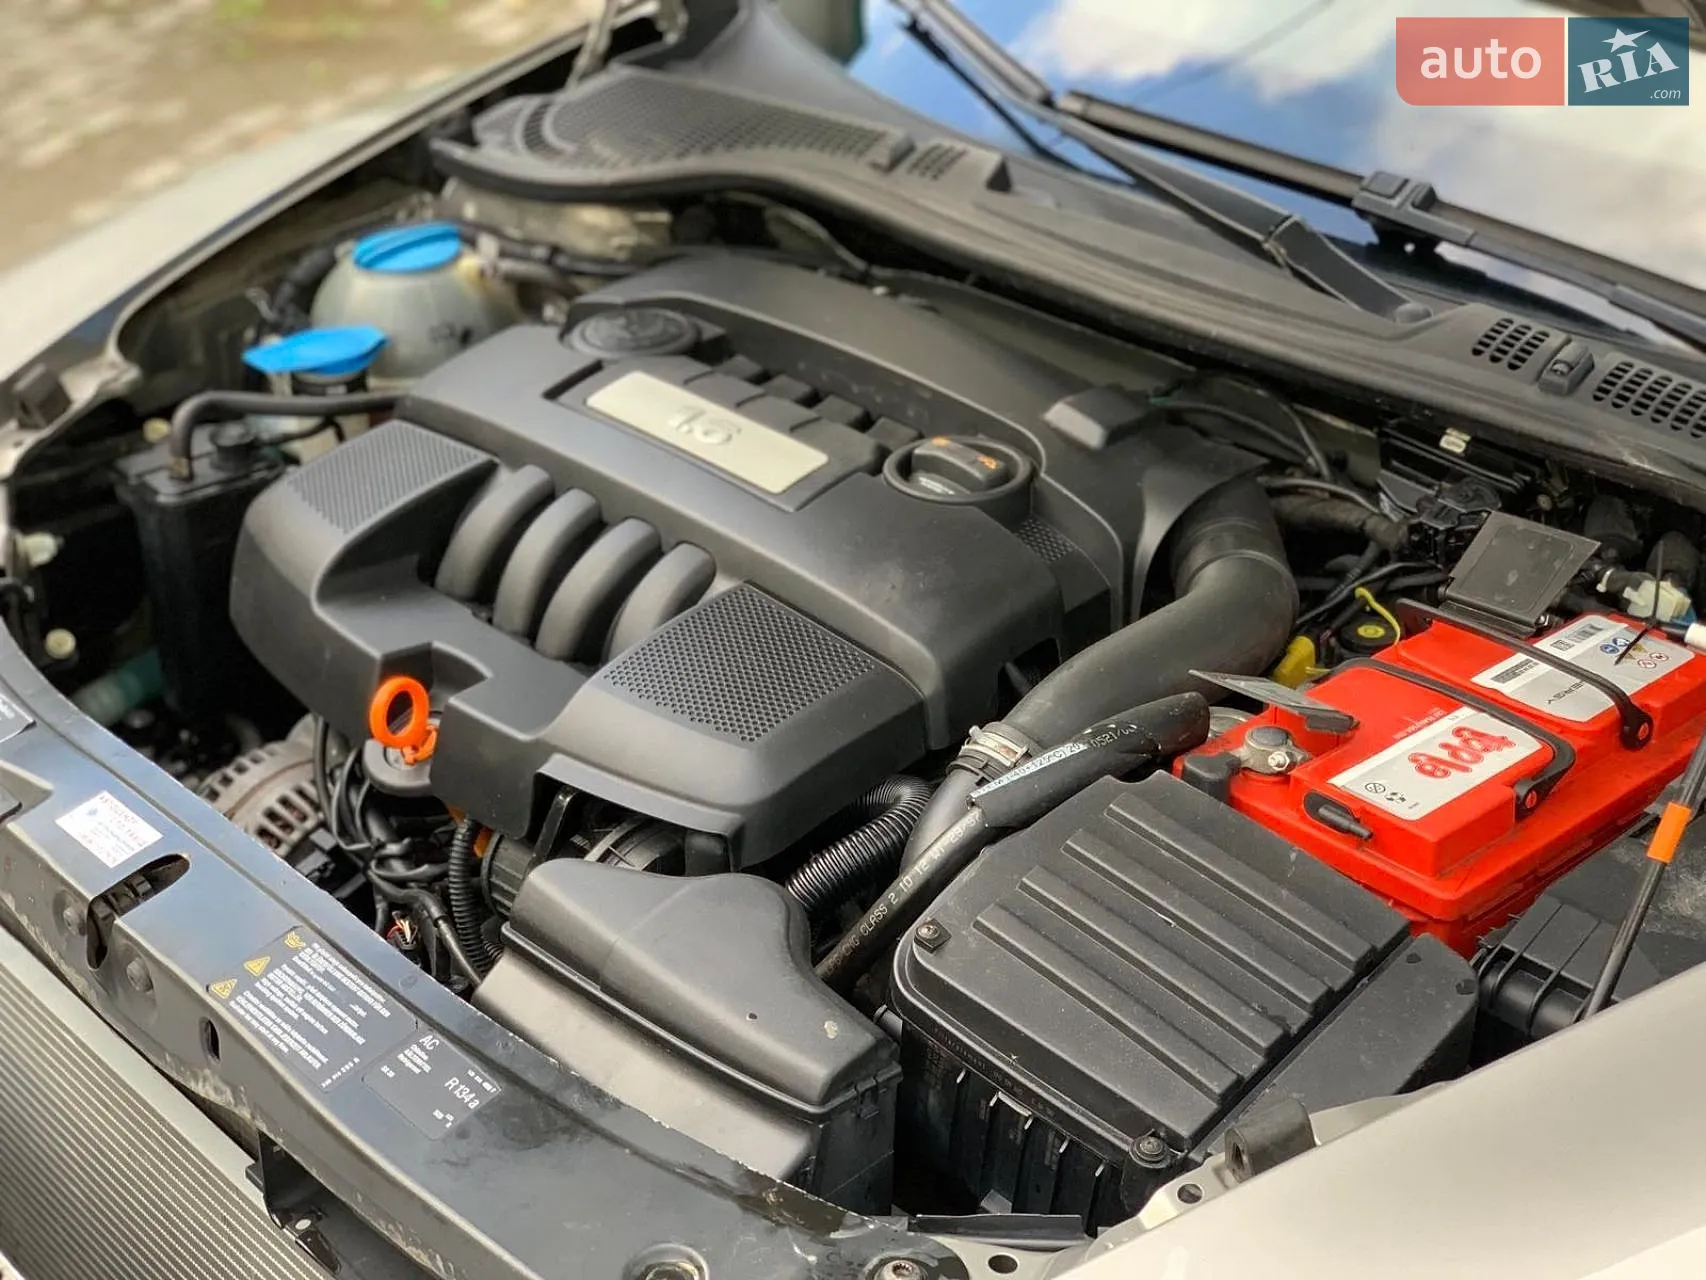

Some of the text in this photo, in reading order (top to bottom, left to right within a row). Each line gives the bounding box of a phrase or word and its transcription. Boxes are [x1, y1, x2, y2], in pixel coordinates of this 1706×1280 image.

[859, 903, 889, 937] CLASS
[887, 892, 899, 905] 2
[419, 1034, 440, 1051] AC
